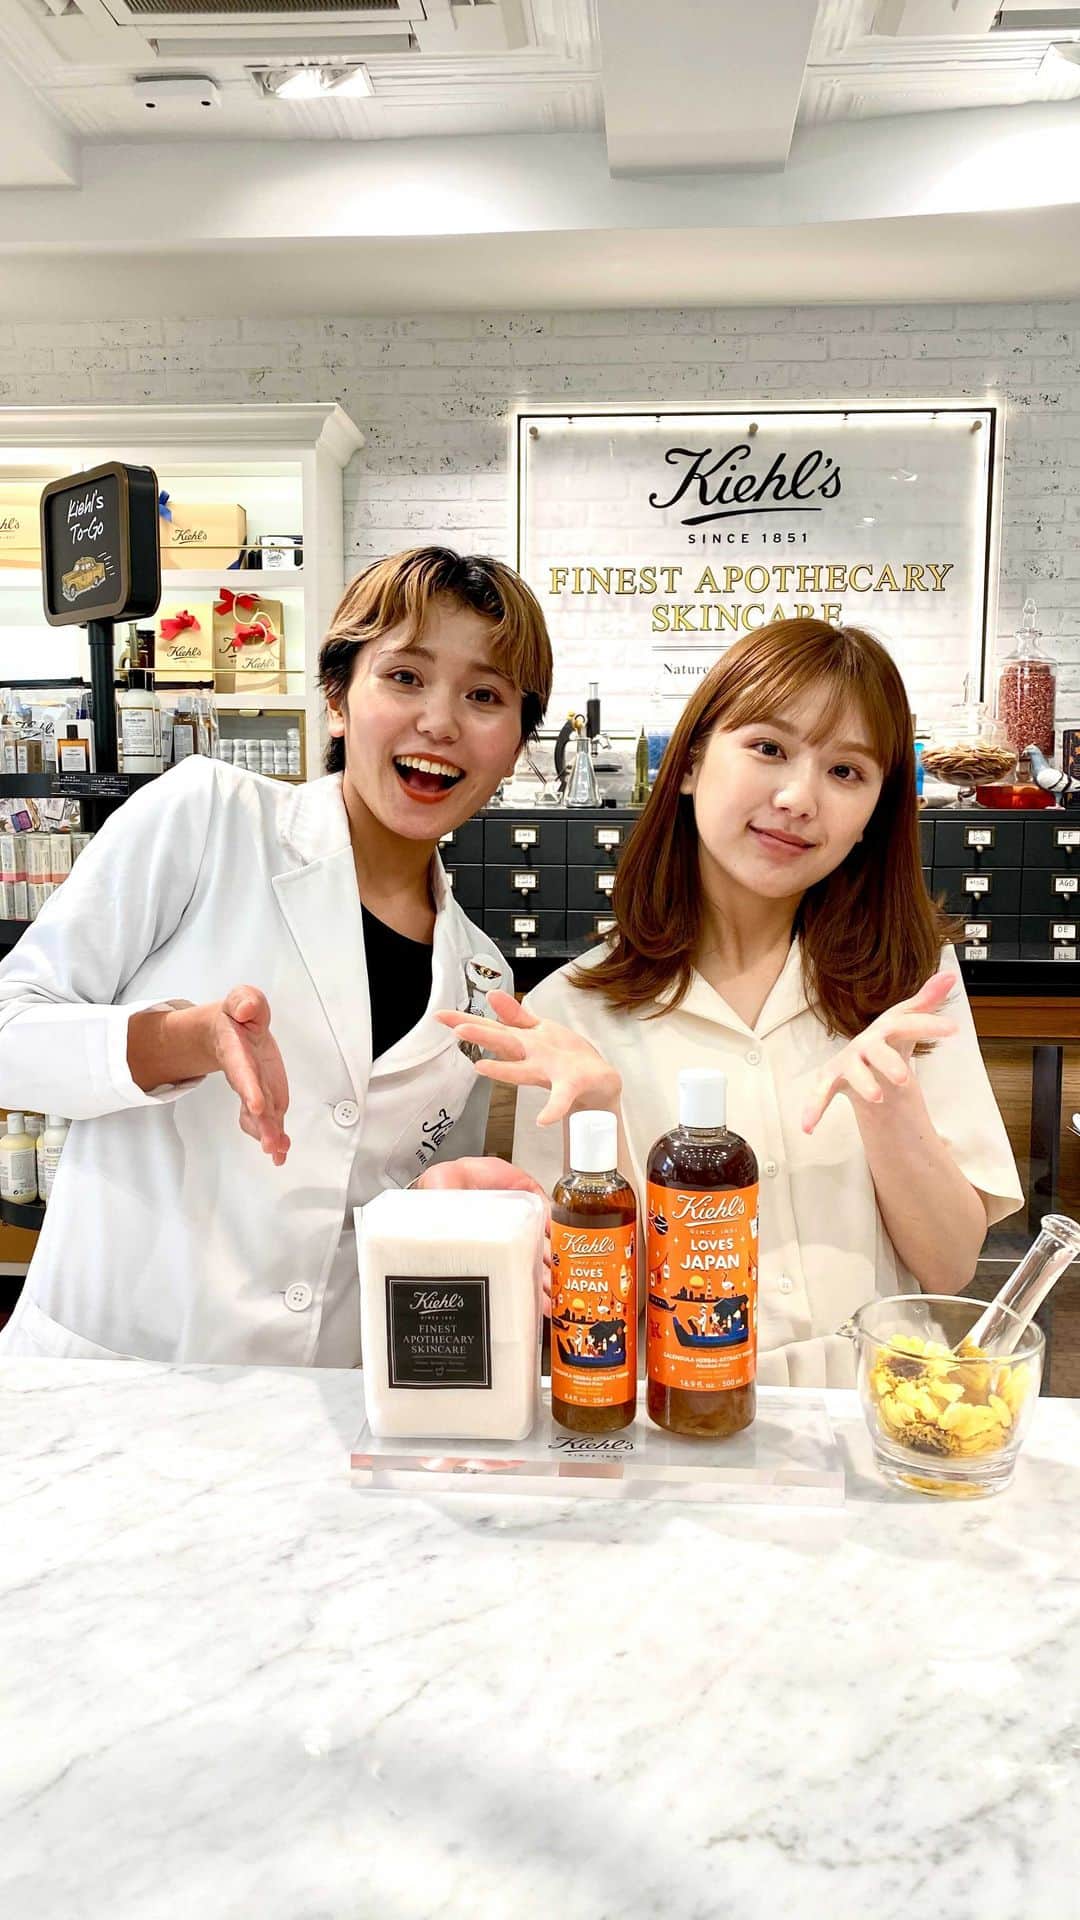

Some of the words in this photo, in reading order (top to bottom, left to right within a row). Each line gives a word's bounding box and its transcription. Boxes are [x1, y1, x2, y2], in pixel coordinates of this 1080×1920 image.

[648, 444, 841, 508] Kiehl's
[67, 489, 104, 524] Kiehl's
[70, 516, 104, 545] To-Go
[172, 529, 208, 541] Kiehl's
[688, 533, 750, 544] SINCE
[762, 532, 808, 544] 1851
[549, 566, 683, 595] FINEST
[693, 563, 954, 594] APOTHECARY
[166, 645, 202, 657] Kiehl's
[671, 1194, 745, 1220] Kiehl's
[560, 1232, 615, 1254] Kiehl's
[690, 1238, 734, 1251] LOVES
[680, 1254, 740, 1271] JAPAN
[570, 1267, 603, 1278] LOVES
[564, 1279, 609, 1292] JAPAN
[409, 1291, 464, 1310] Kiehl's
[419, 1324, 457, 1334] FINEST
[403, 1335, 475, 1345] APOTHECARY
[411, 1345, 467, 1354] SKINCARE
[547, 1436, 635, 1451] Kiehl's
